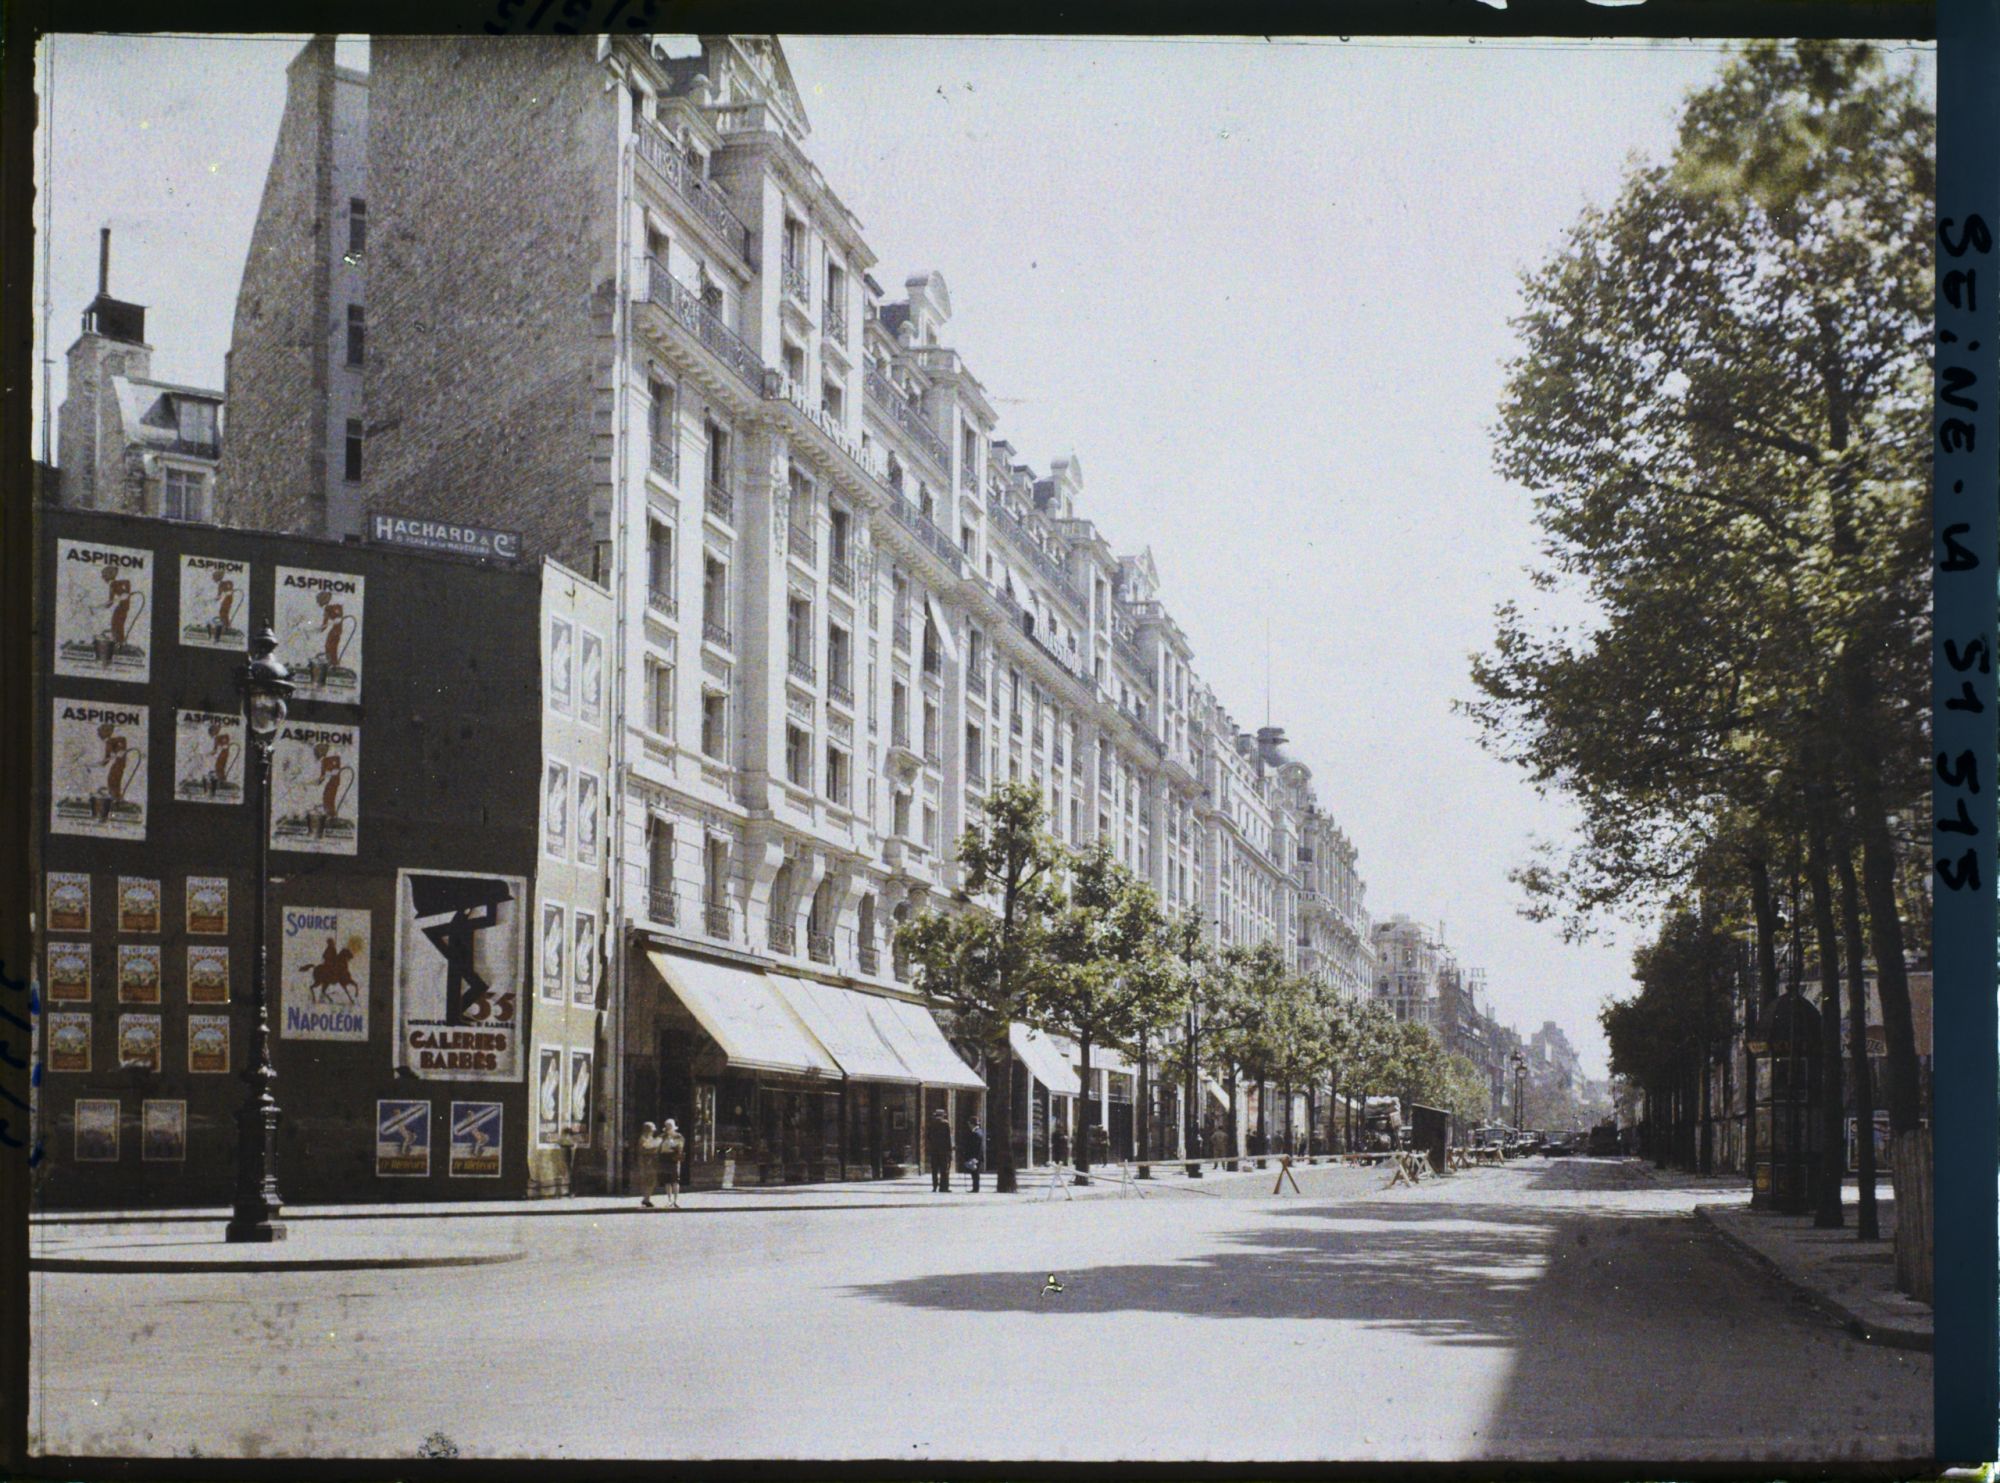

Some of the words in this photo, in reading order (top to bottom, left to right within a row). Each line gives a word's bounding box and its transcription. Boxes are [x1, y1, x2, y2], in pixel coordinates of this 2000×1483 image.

[375, 516, 476, 543] HACHARD
[479, 536, 489, 546] &
[67, 548, 144, 569] ASPIRON
[188, 557, 243, 573] ASPIRON
[284, 574, 356, 594] ASPIRON
[62, 706, 140, 726] ASPIRON
[183, 712, 241, 727] ASPIRON
[280, 727, 353, 746] ASPIRON
[286, 912, 337, 936] SOURCE
[287, 1006, 363, 1032] NAPOLÉON
[409, 1030, 507, 1051] GALERIES
